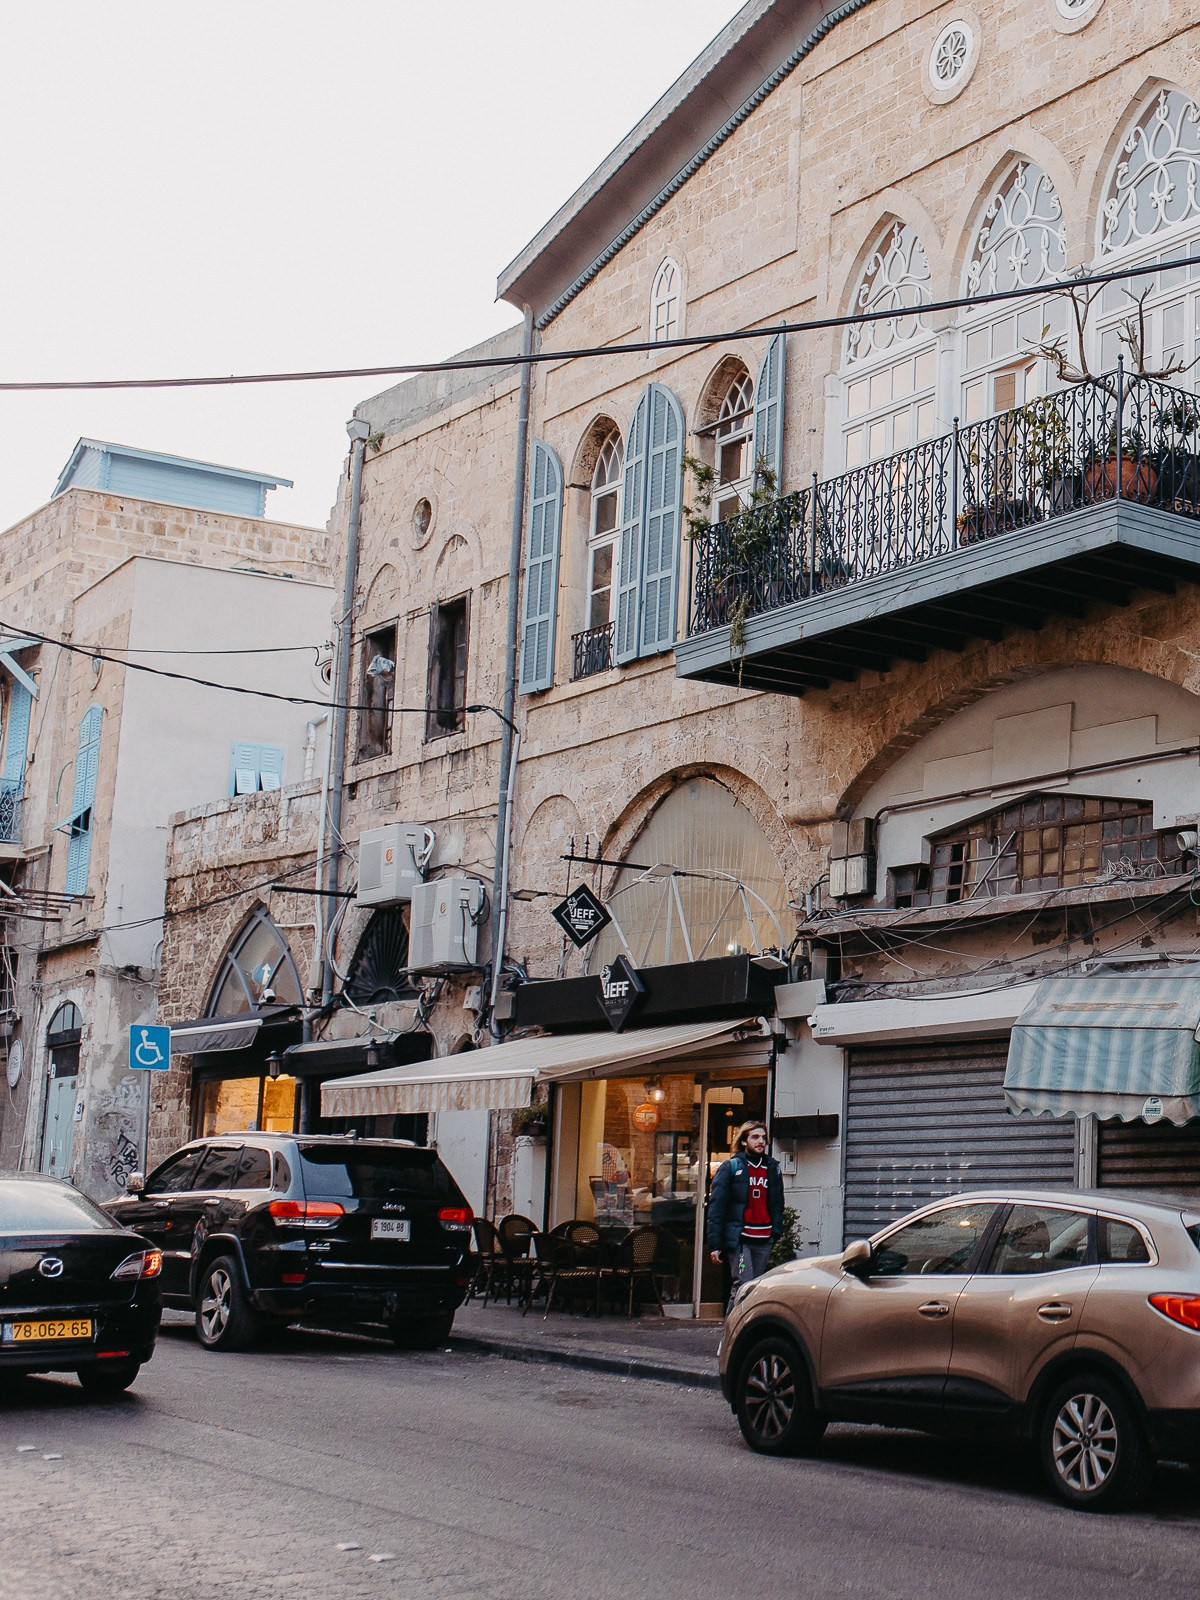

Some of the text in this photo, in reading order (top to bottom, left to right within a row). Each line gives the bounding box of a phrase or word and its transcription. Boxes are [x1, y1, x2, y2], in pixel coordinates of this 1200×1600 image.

[571, 908, 595, 919] JEFF
[604, 981, 630, 998] JEFF
[76, 1102, 82, 1114] 3
[382, 1202, 405, 1212] Jeep
